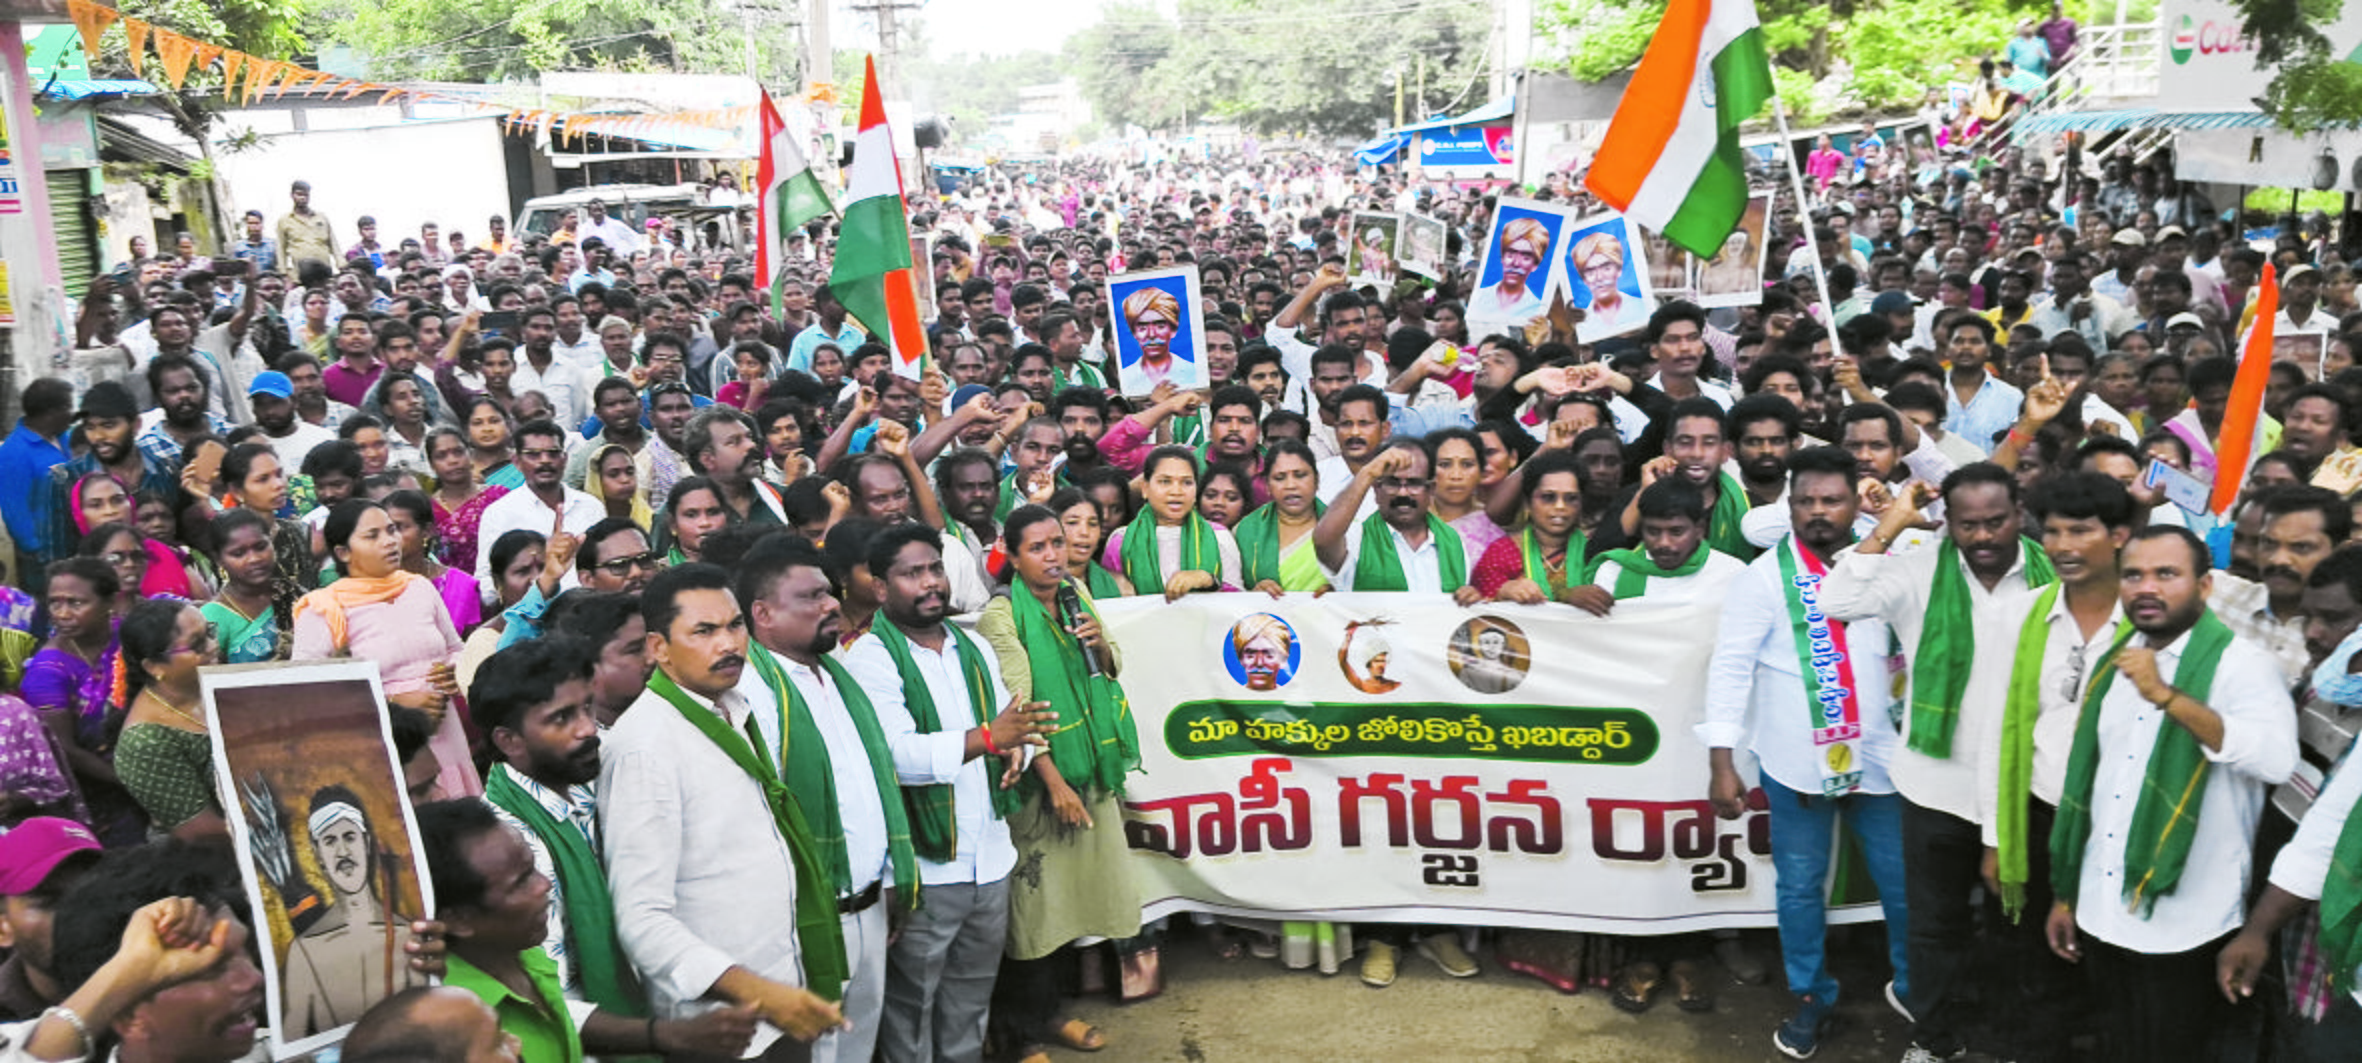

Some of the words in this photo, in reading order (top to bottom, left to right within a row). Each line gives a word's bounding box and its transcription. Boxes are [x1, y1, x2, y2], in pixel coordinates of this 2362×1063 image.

[1187, 716, 1239, 743] మా
[1244, 717, 1351, 751] హక్కుల
[1357, 714, 1498, 752] జోలికొస్తే
[1124, 758, 1312, 859] వాసీ
[1337, 772, 1563, 887] గర్జన
[1586, 787, 1771, 893] ర్యా
